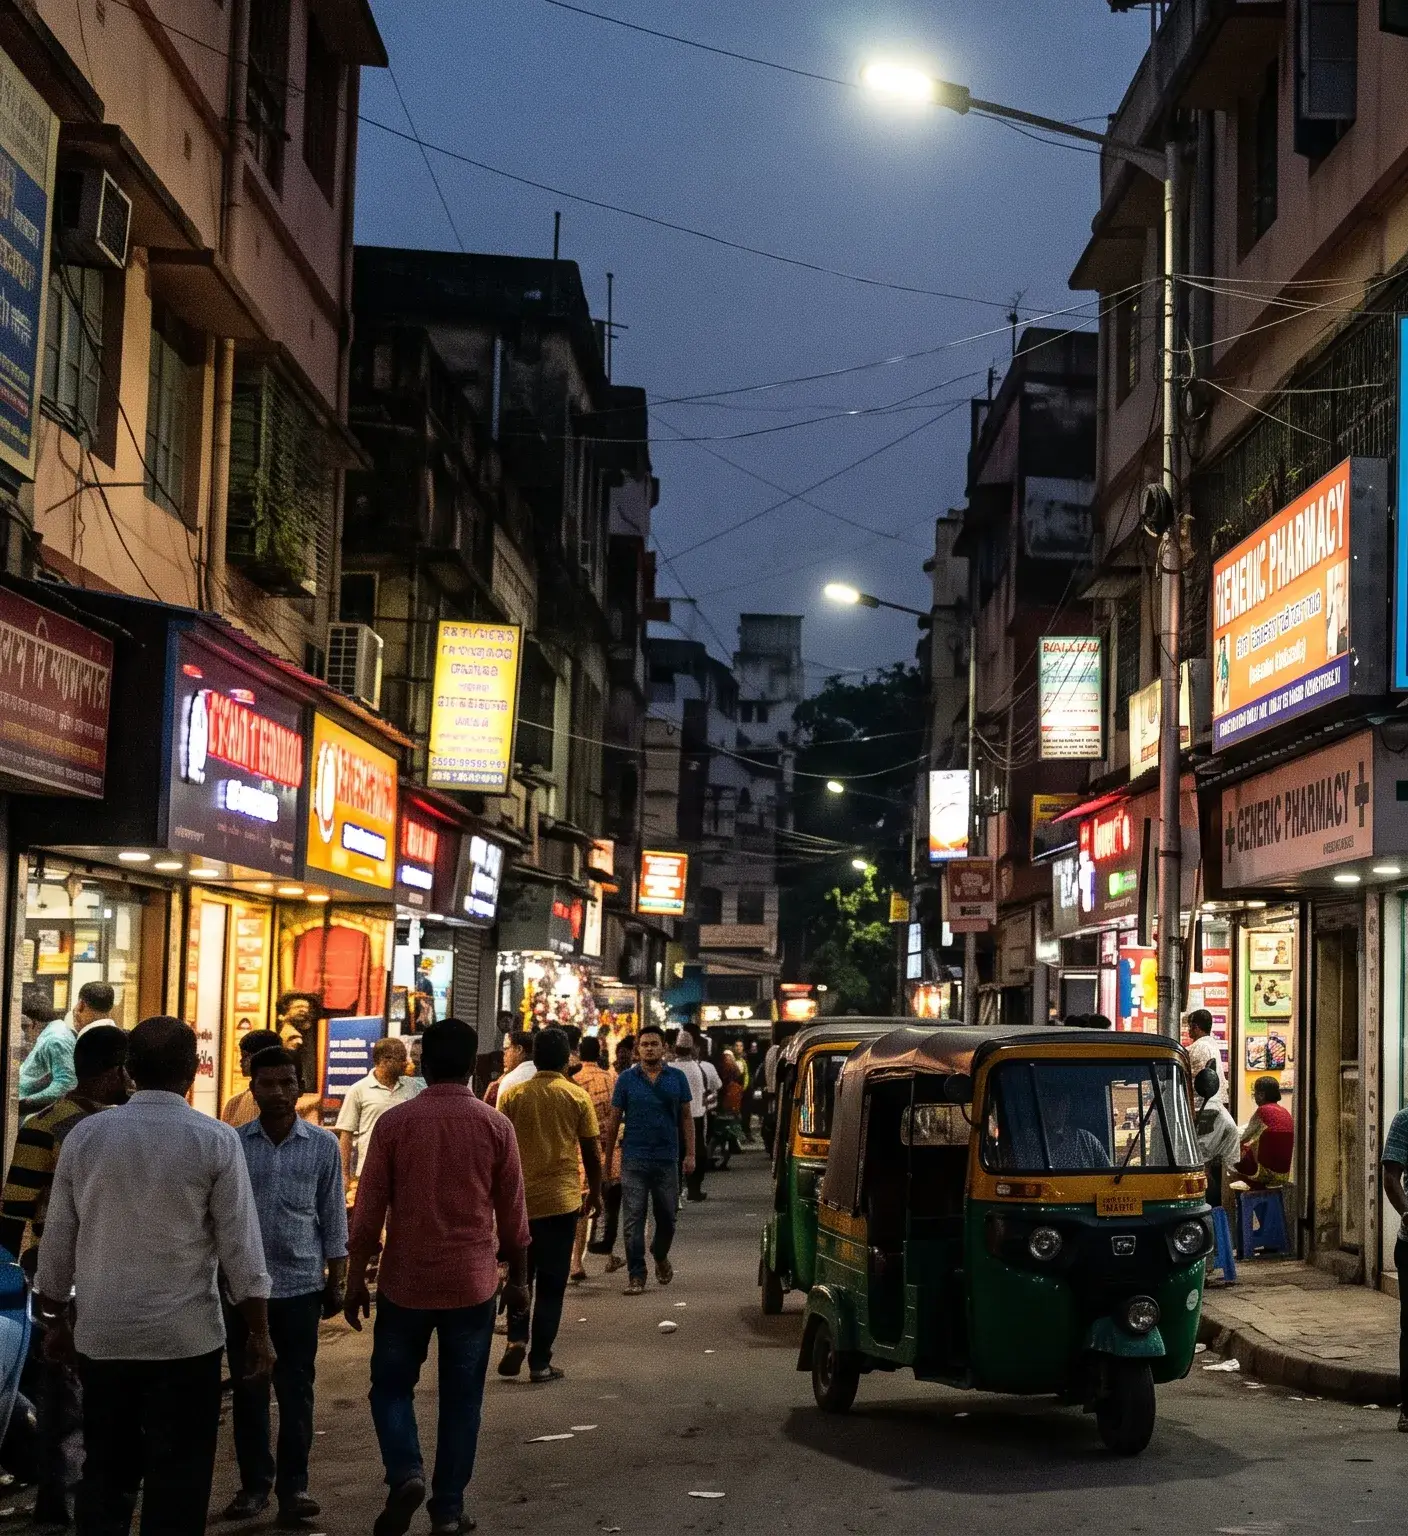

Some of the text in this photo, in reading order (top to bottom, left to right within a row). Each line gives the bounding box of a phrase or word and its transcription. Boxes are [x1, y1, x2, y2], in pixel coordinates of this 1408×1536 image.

[1269, 480, 1345, 595] PHARMACY
[1238, 769, 1351, 853] GENERIC PHARMACY
